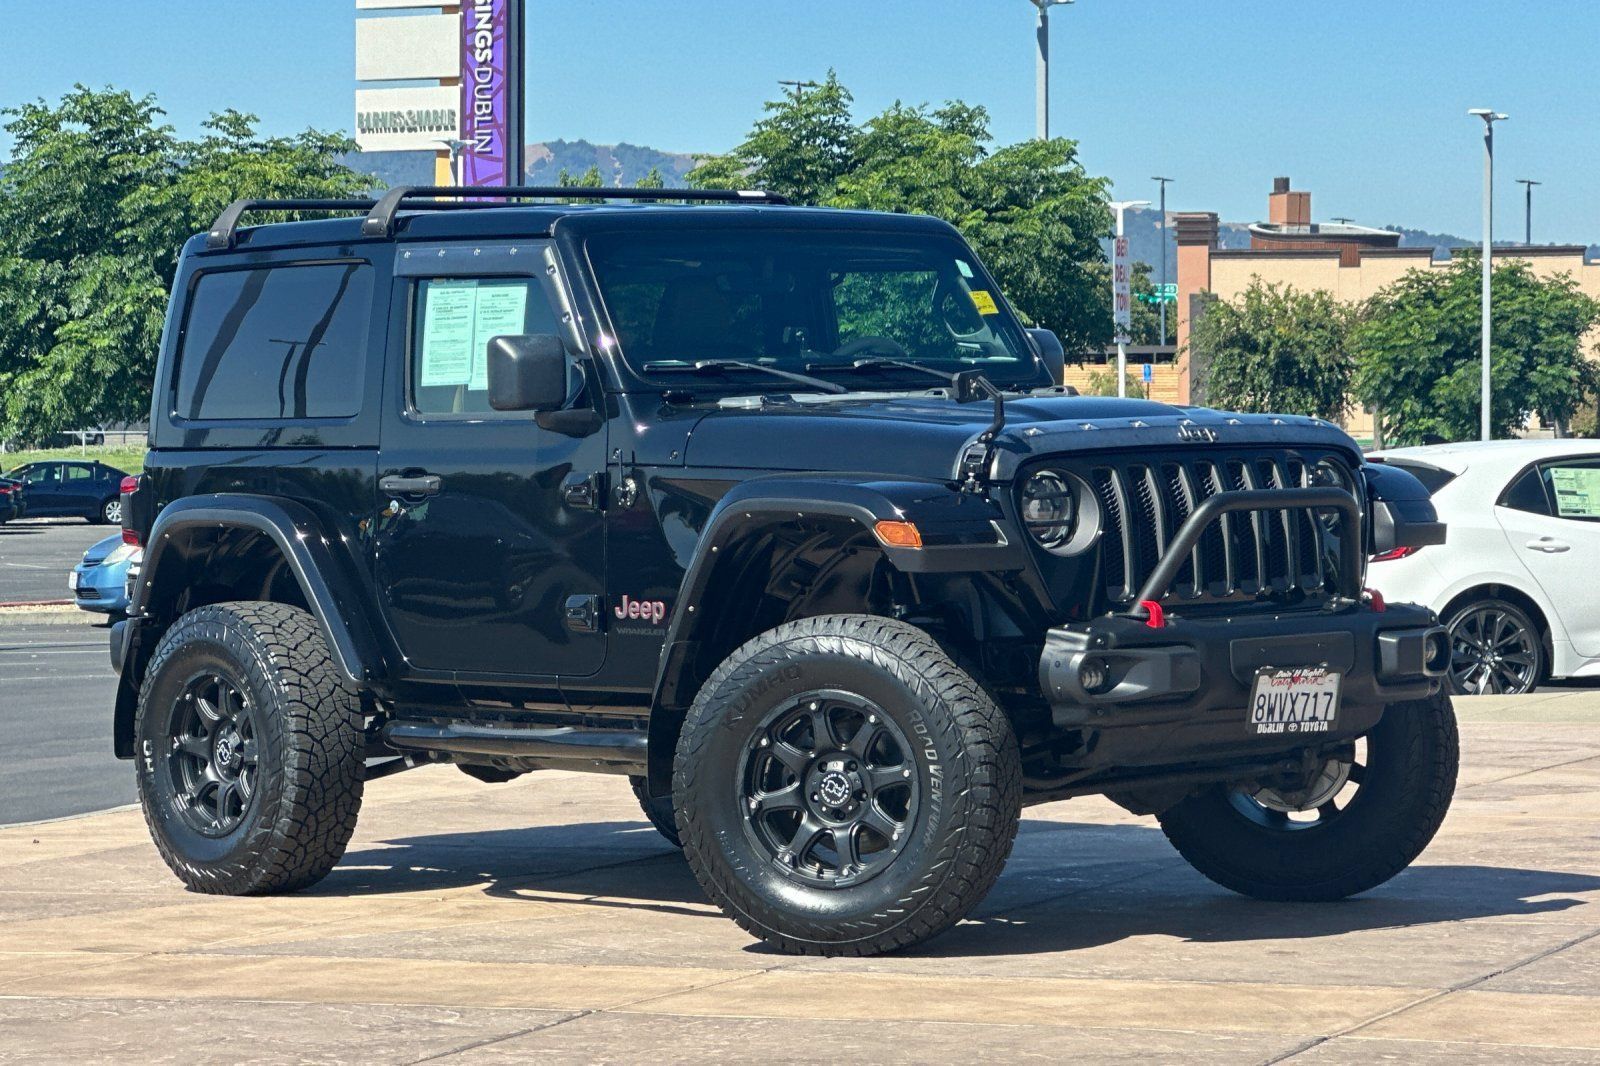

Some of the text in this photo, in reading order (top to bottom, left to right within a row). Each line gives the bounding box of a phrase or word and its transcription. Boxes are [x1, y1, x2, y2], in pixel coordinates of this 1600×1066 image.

[474, 67, 493, 155] DUBLIN
[1177, 424, 1219, 443] Jeep
[614, 594, 665, 625] Jeep
[1255, 691, 1334, 722] 8WVX717
[1257, 721, 1328, 734] DUBLIN TOYOTA
